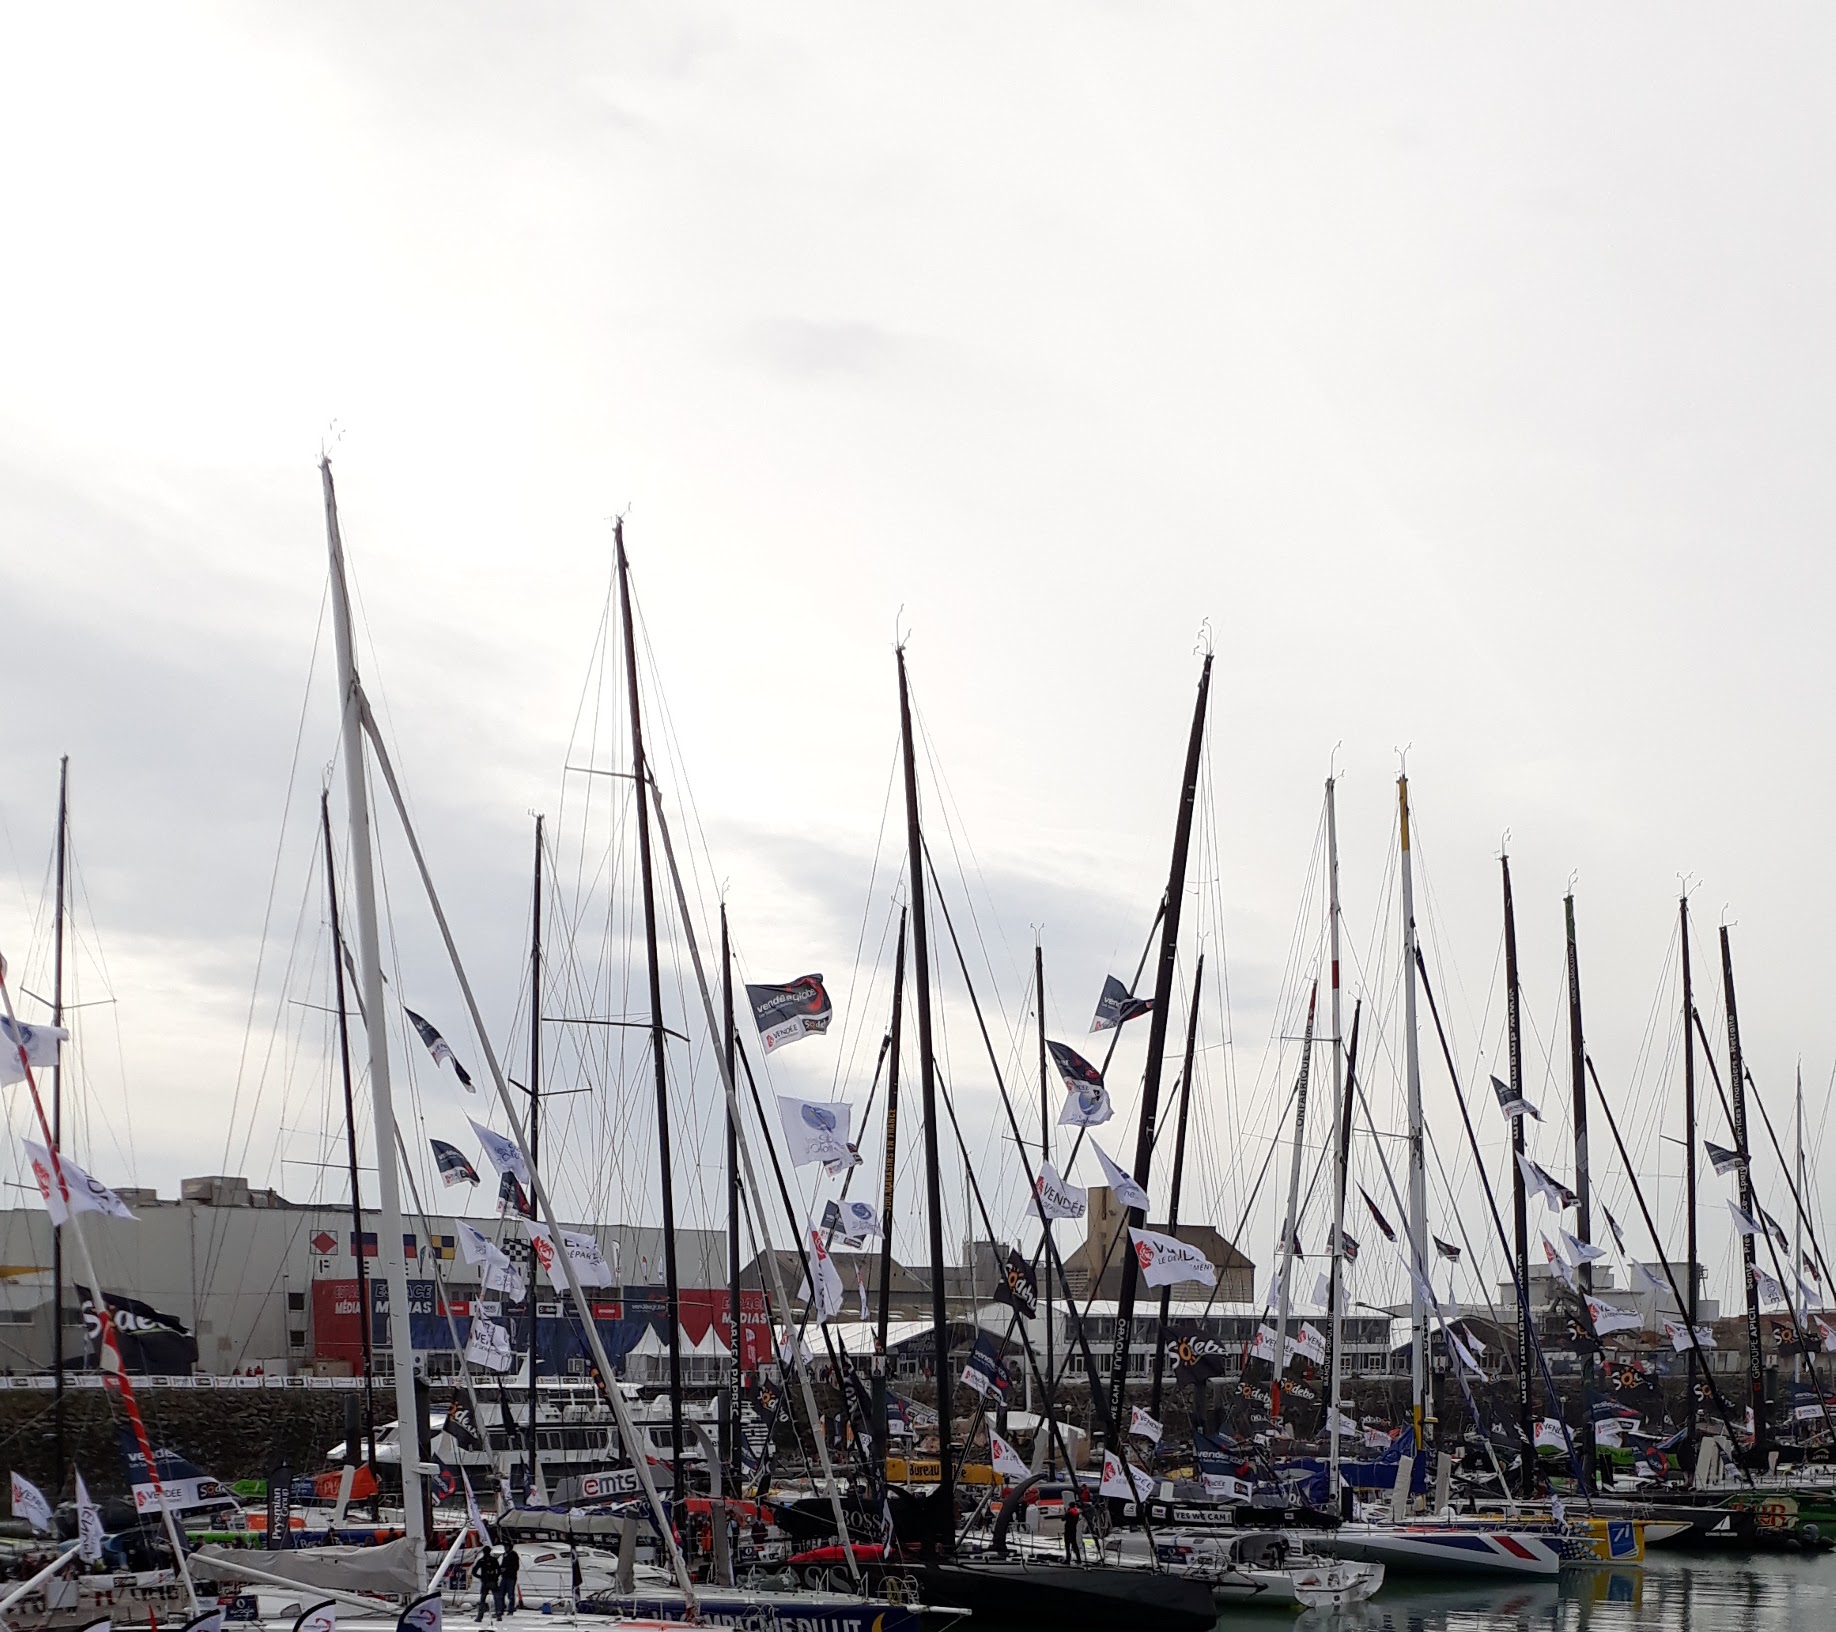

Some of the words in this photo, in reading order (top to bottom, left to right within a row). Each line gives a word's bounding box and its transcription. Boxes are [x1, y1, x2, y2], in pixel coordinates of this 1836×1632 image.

[1043, 1183, 1085, 1217] VENDÉE
[721, 1311, 769, 1325] MDIAS
[1748, 1304, 1758, 1337] APICIL
[1750, 1339, 1761, 1379] GROUPE
[730, 1368, 741, 1417] PAPREC
[1111, 1385, 1120, 1404] CAM
[909, 1463, 940, 1477] Bureau
[584, 1474, 637, 1496] emts
[271, 1488, 284, 1541] Prysmian
[1175, 1511, 1190, 1520] YES
[1191, 1512, 1206, 1521] WE
[1207, 1512, 1225, 1522] CAM
